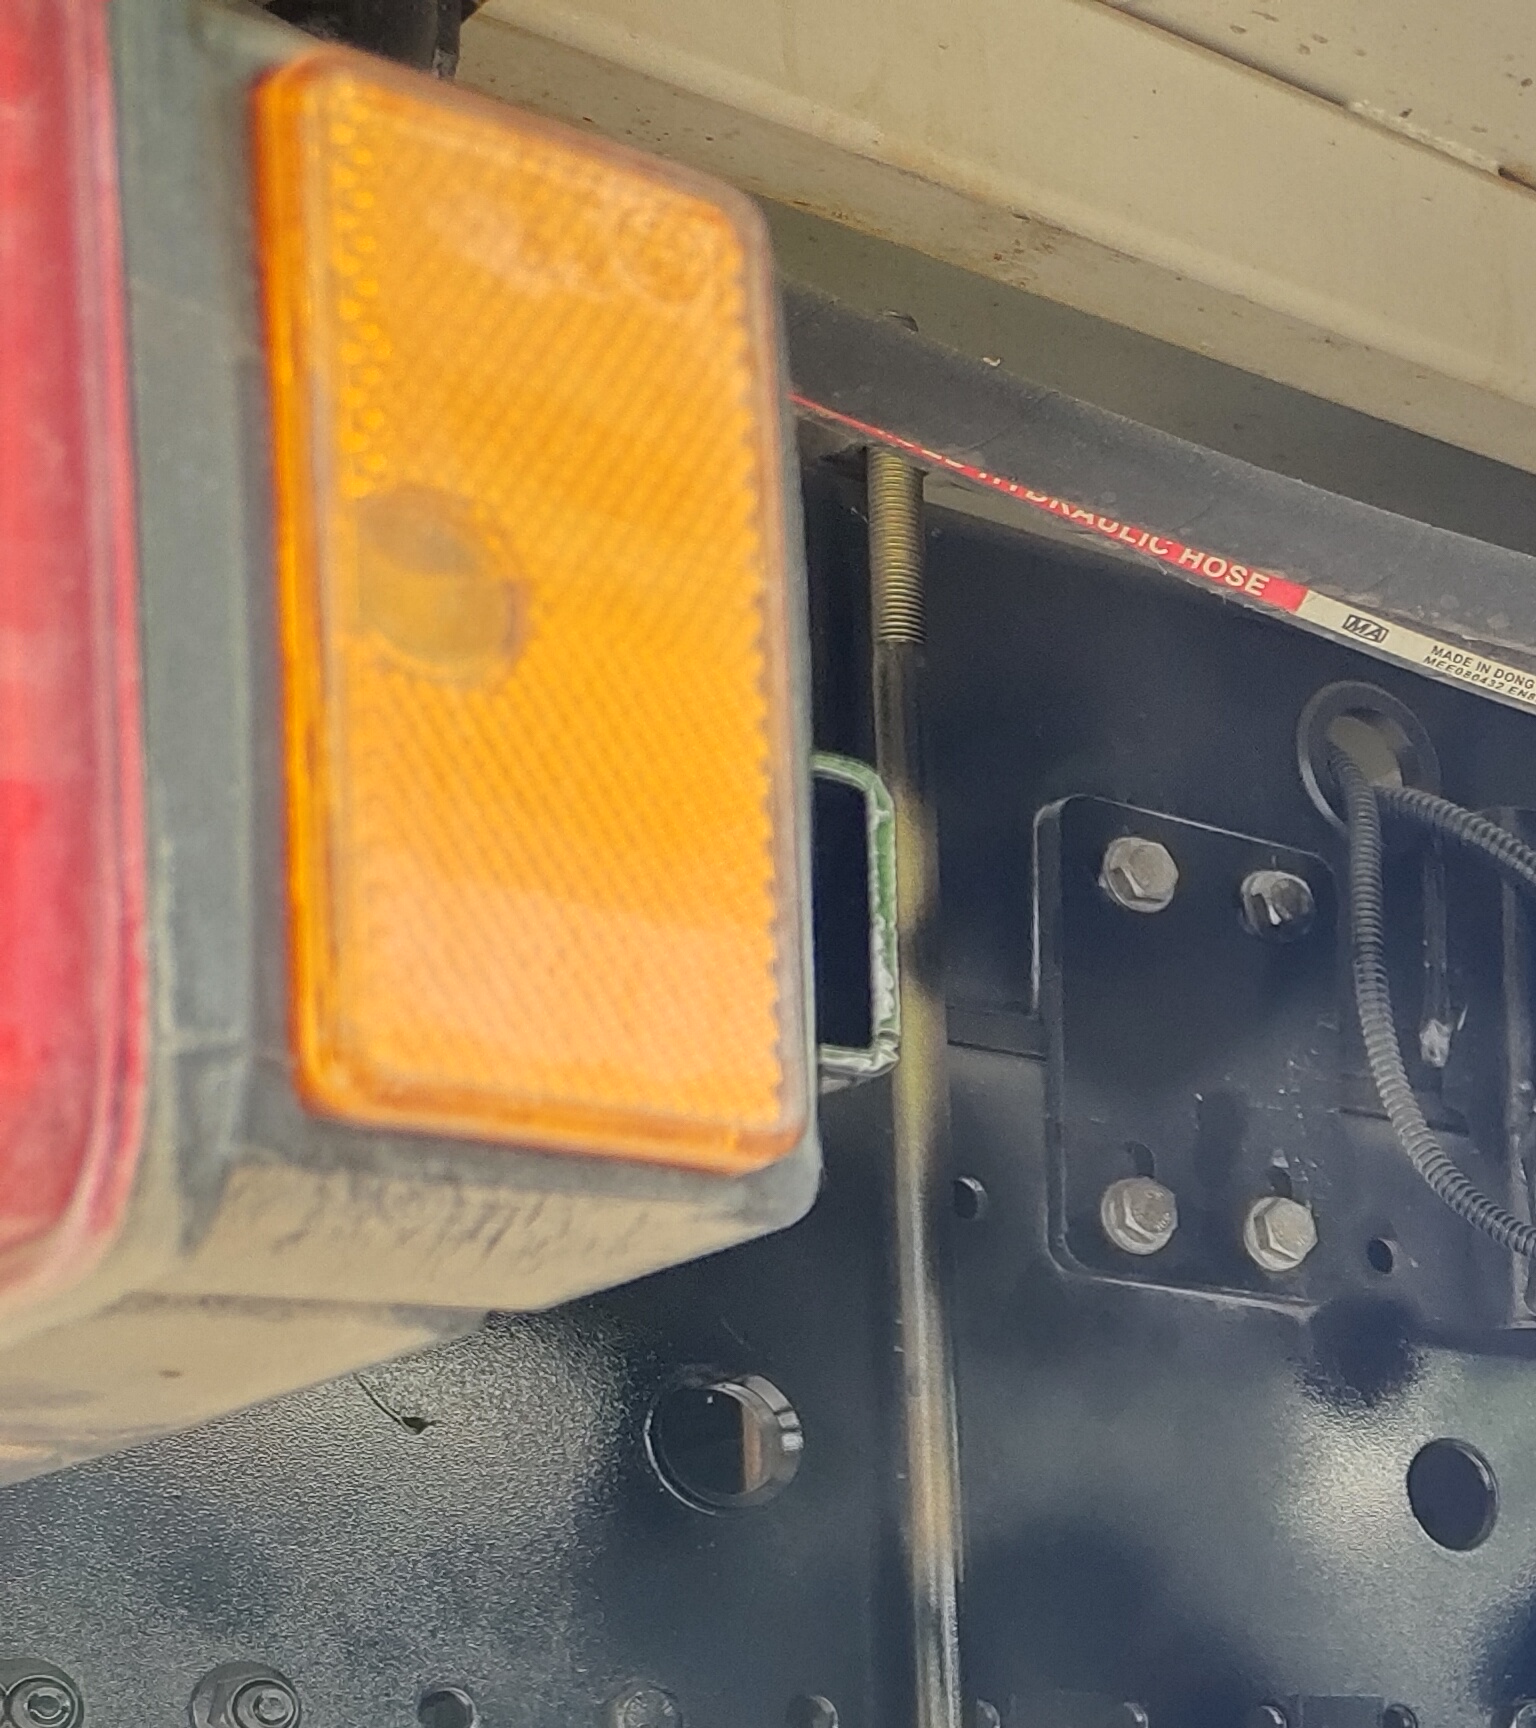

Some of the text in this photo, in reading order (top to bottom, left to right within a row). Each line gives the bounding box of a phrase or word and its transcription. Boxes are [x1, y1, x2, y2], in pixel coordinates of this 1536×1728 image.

[978, 472, 1271, 597] DRAULIC HOSE
[1431, 645, 1473, 667] MADE
[1475, 661, 1492, 674] IN
[1494, 668, 1535, 690] DONG
